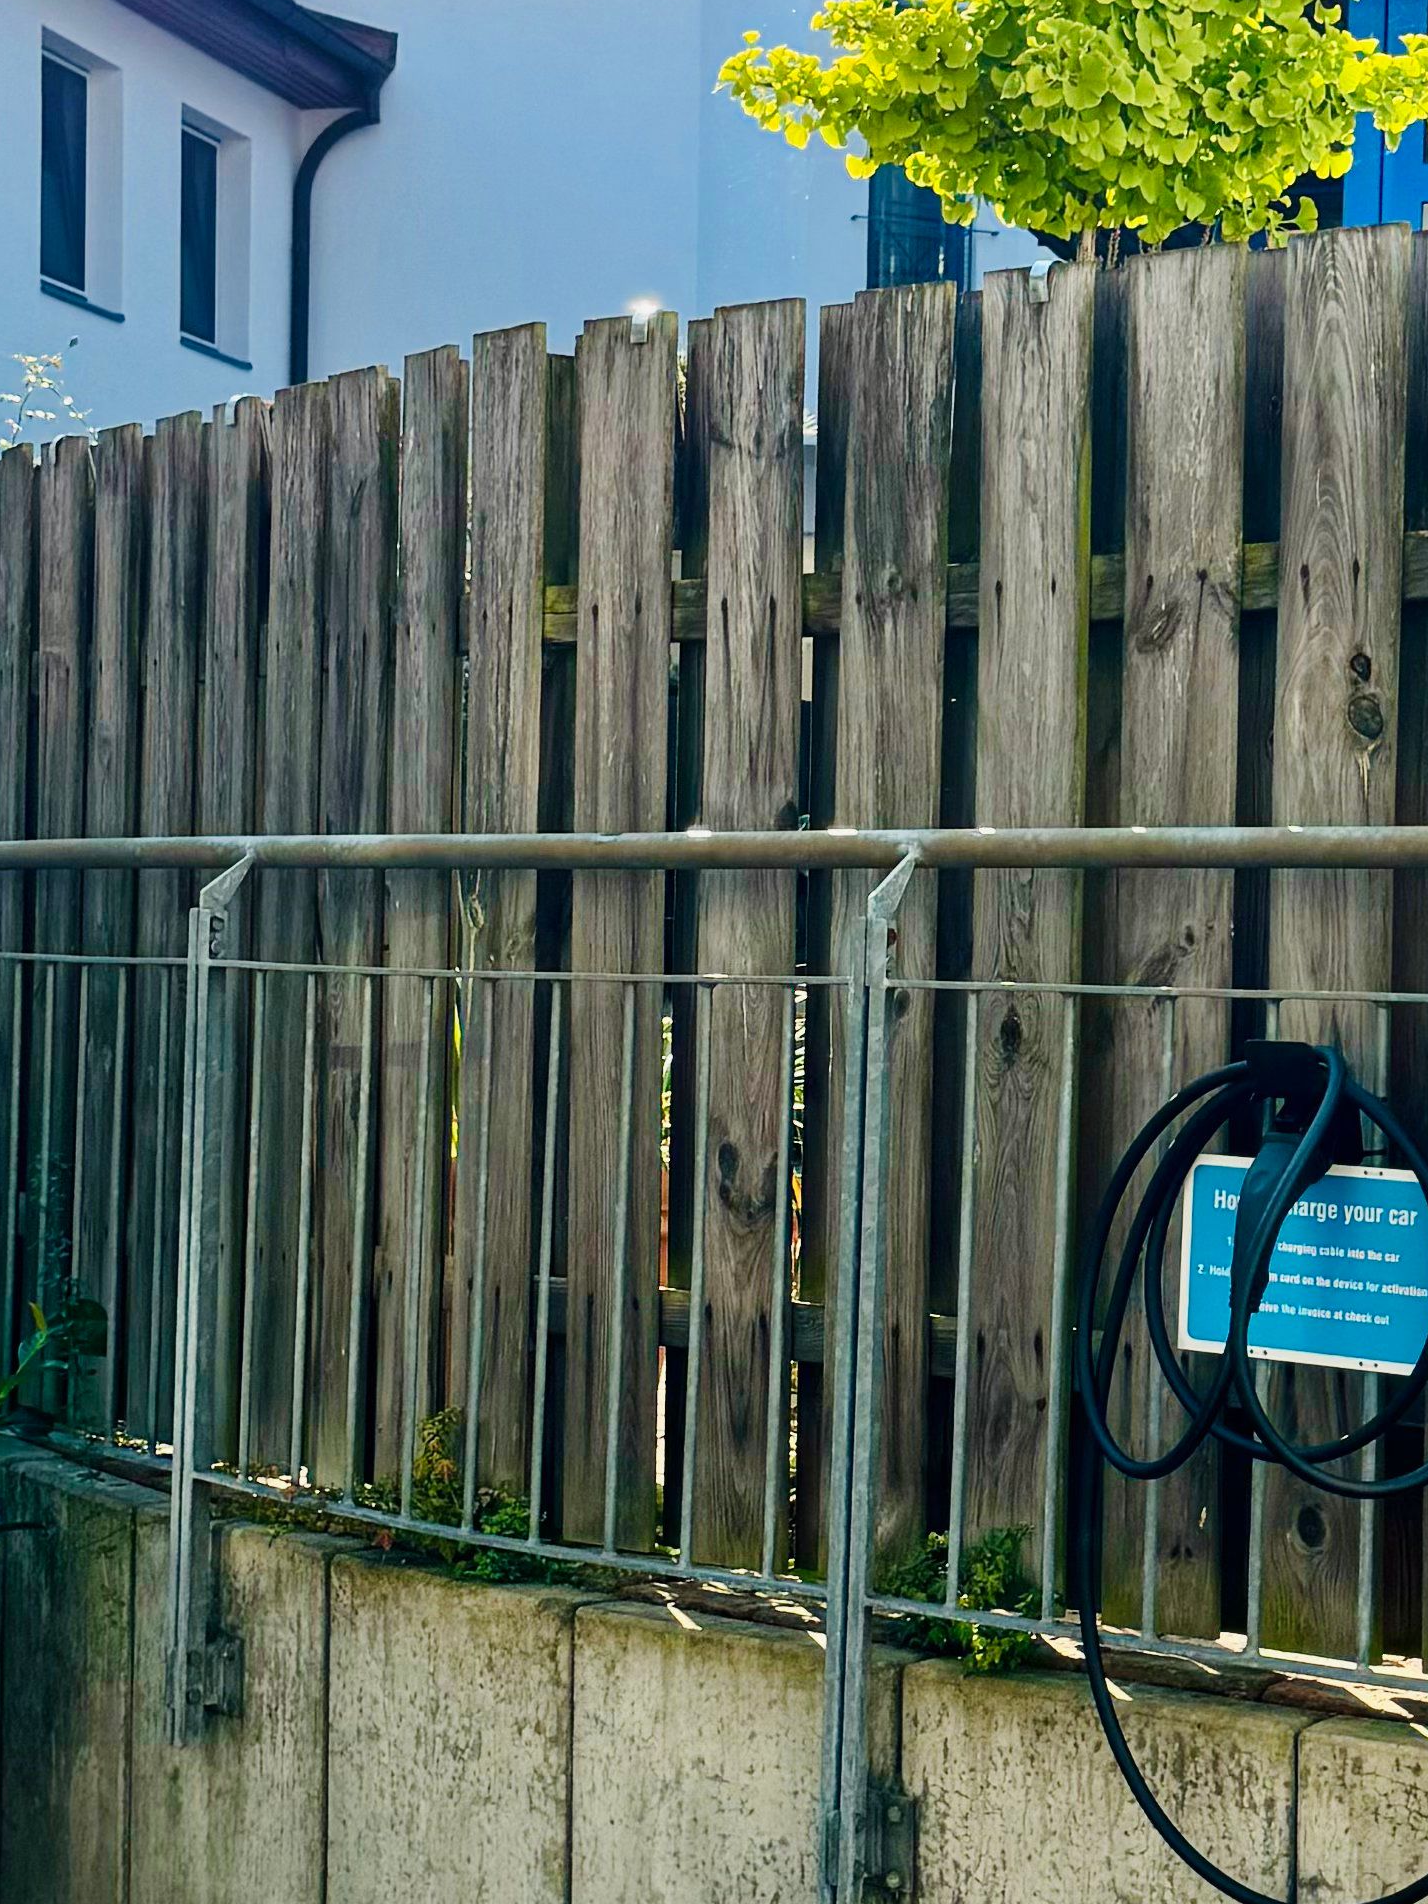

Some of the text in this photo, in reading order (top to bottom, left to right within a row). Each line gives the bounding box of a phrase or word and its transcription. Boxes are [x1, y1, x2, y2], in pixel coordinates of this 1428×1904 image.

[1214, 1189, 1240, 1211] Ho
[1344, 1205, 1384, 1224] your
[1389, 1209, 1418, 1226] car
[1278, 1241, 1317, 1256] charging
[1320, 1246, 1344, 1257] cable
[1348, 1248, 1365, 1260] into
[1368, 1250, 1382, 1261] the
[1384, 1253, 1400, 1262] car
[1280, 1274, 1300, 1286] card
[1302, 1276, 1314, 1286] on
[1316, 1276, 1330, 1288] the
[1333, 1278, 1364, 1291] device
[1366, 1282, 1379, 1292] for
[1382, 1284, 1428, 1297] activation
[1258, 1300, 1390, 1326] eive the invoice at check out
